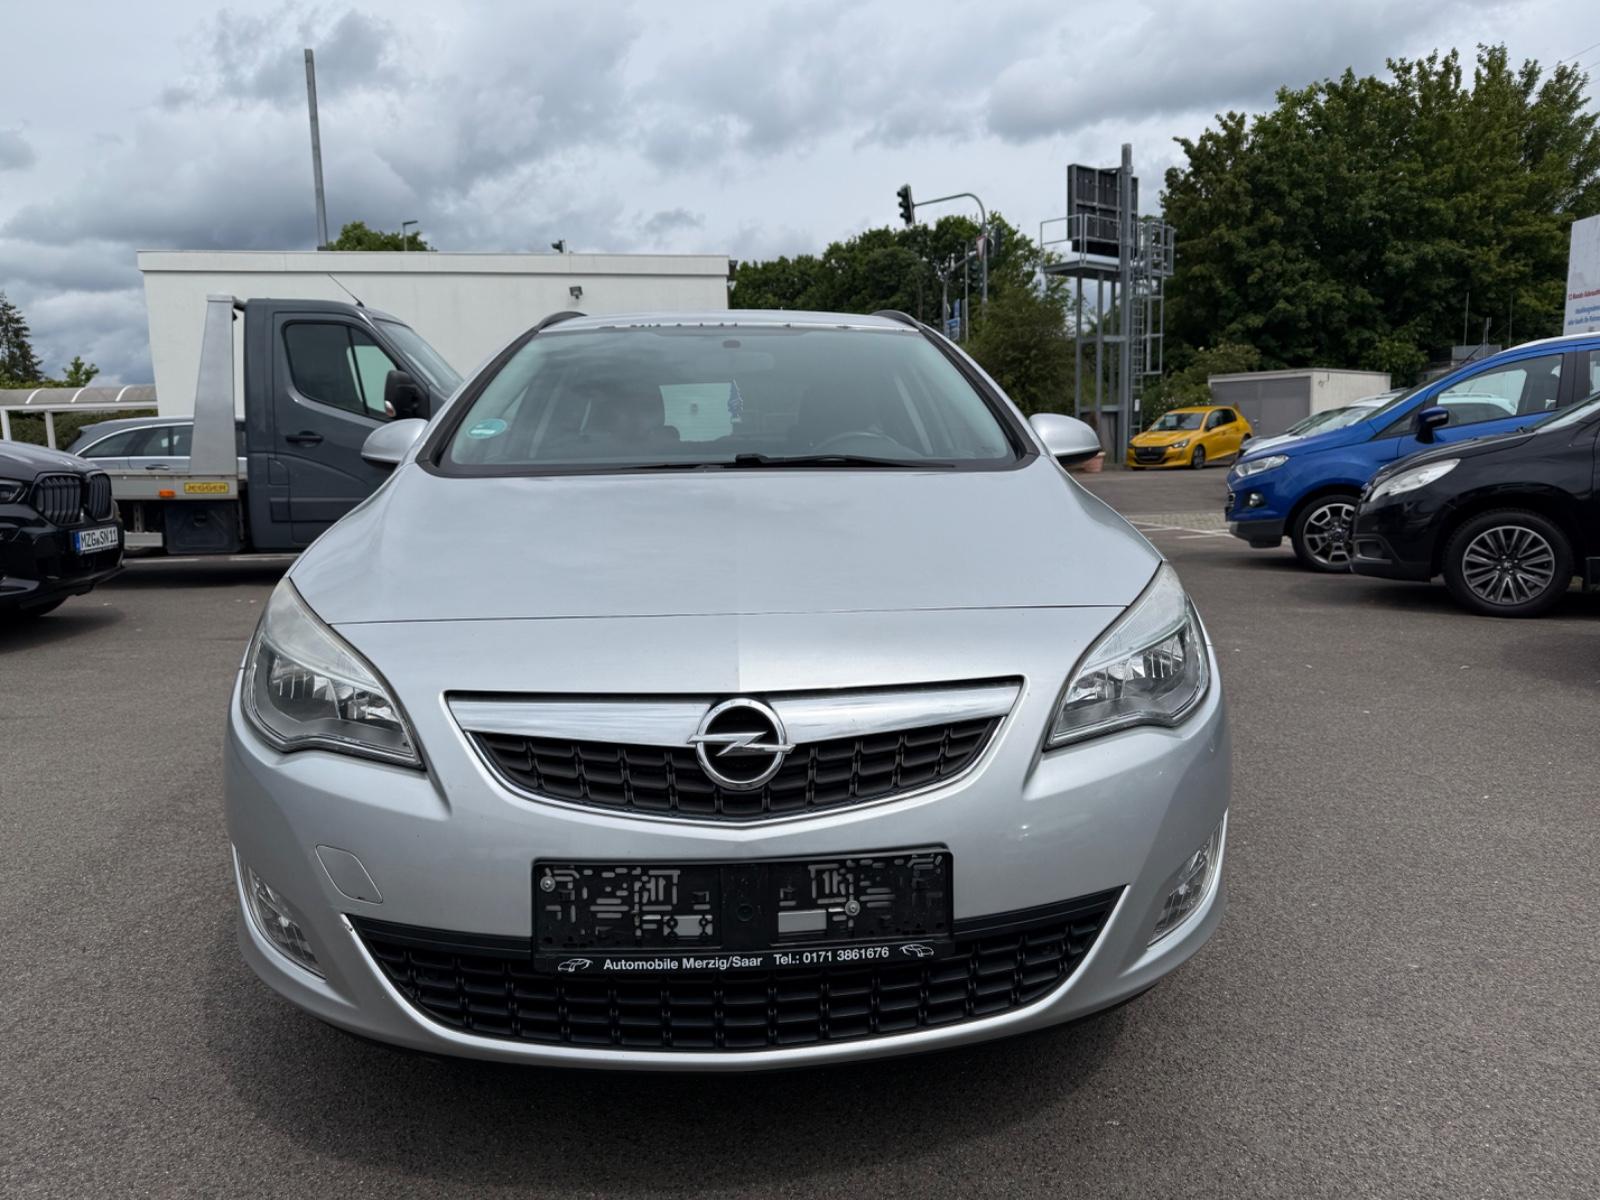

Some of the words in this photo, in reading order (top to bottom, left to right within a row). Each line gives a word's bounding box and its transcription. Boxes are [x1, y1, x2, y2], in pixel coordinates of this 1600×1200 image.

[604, 958, 679, 970] Automobile
[682, 956, 763, 970] Merzig/Saar
[773, 953, 799, 965] Tel.:
[803, 950, 833, 963] 0171
[837, 947, 890, 961] 3861676
